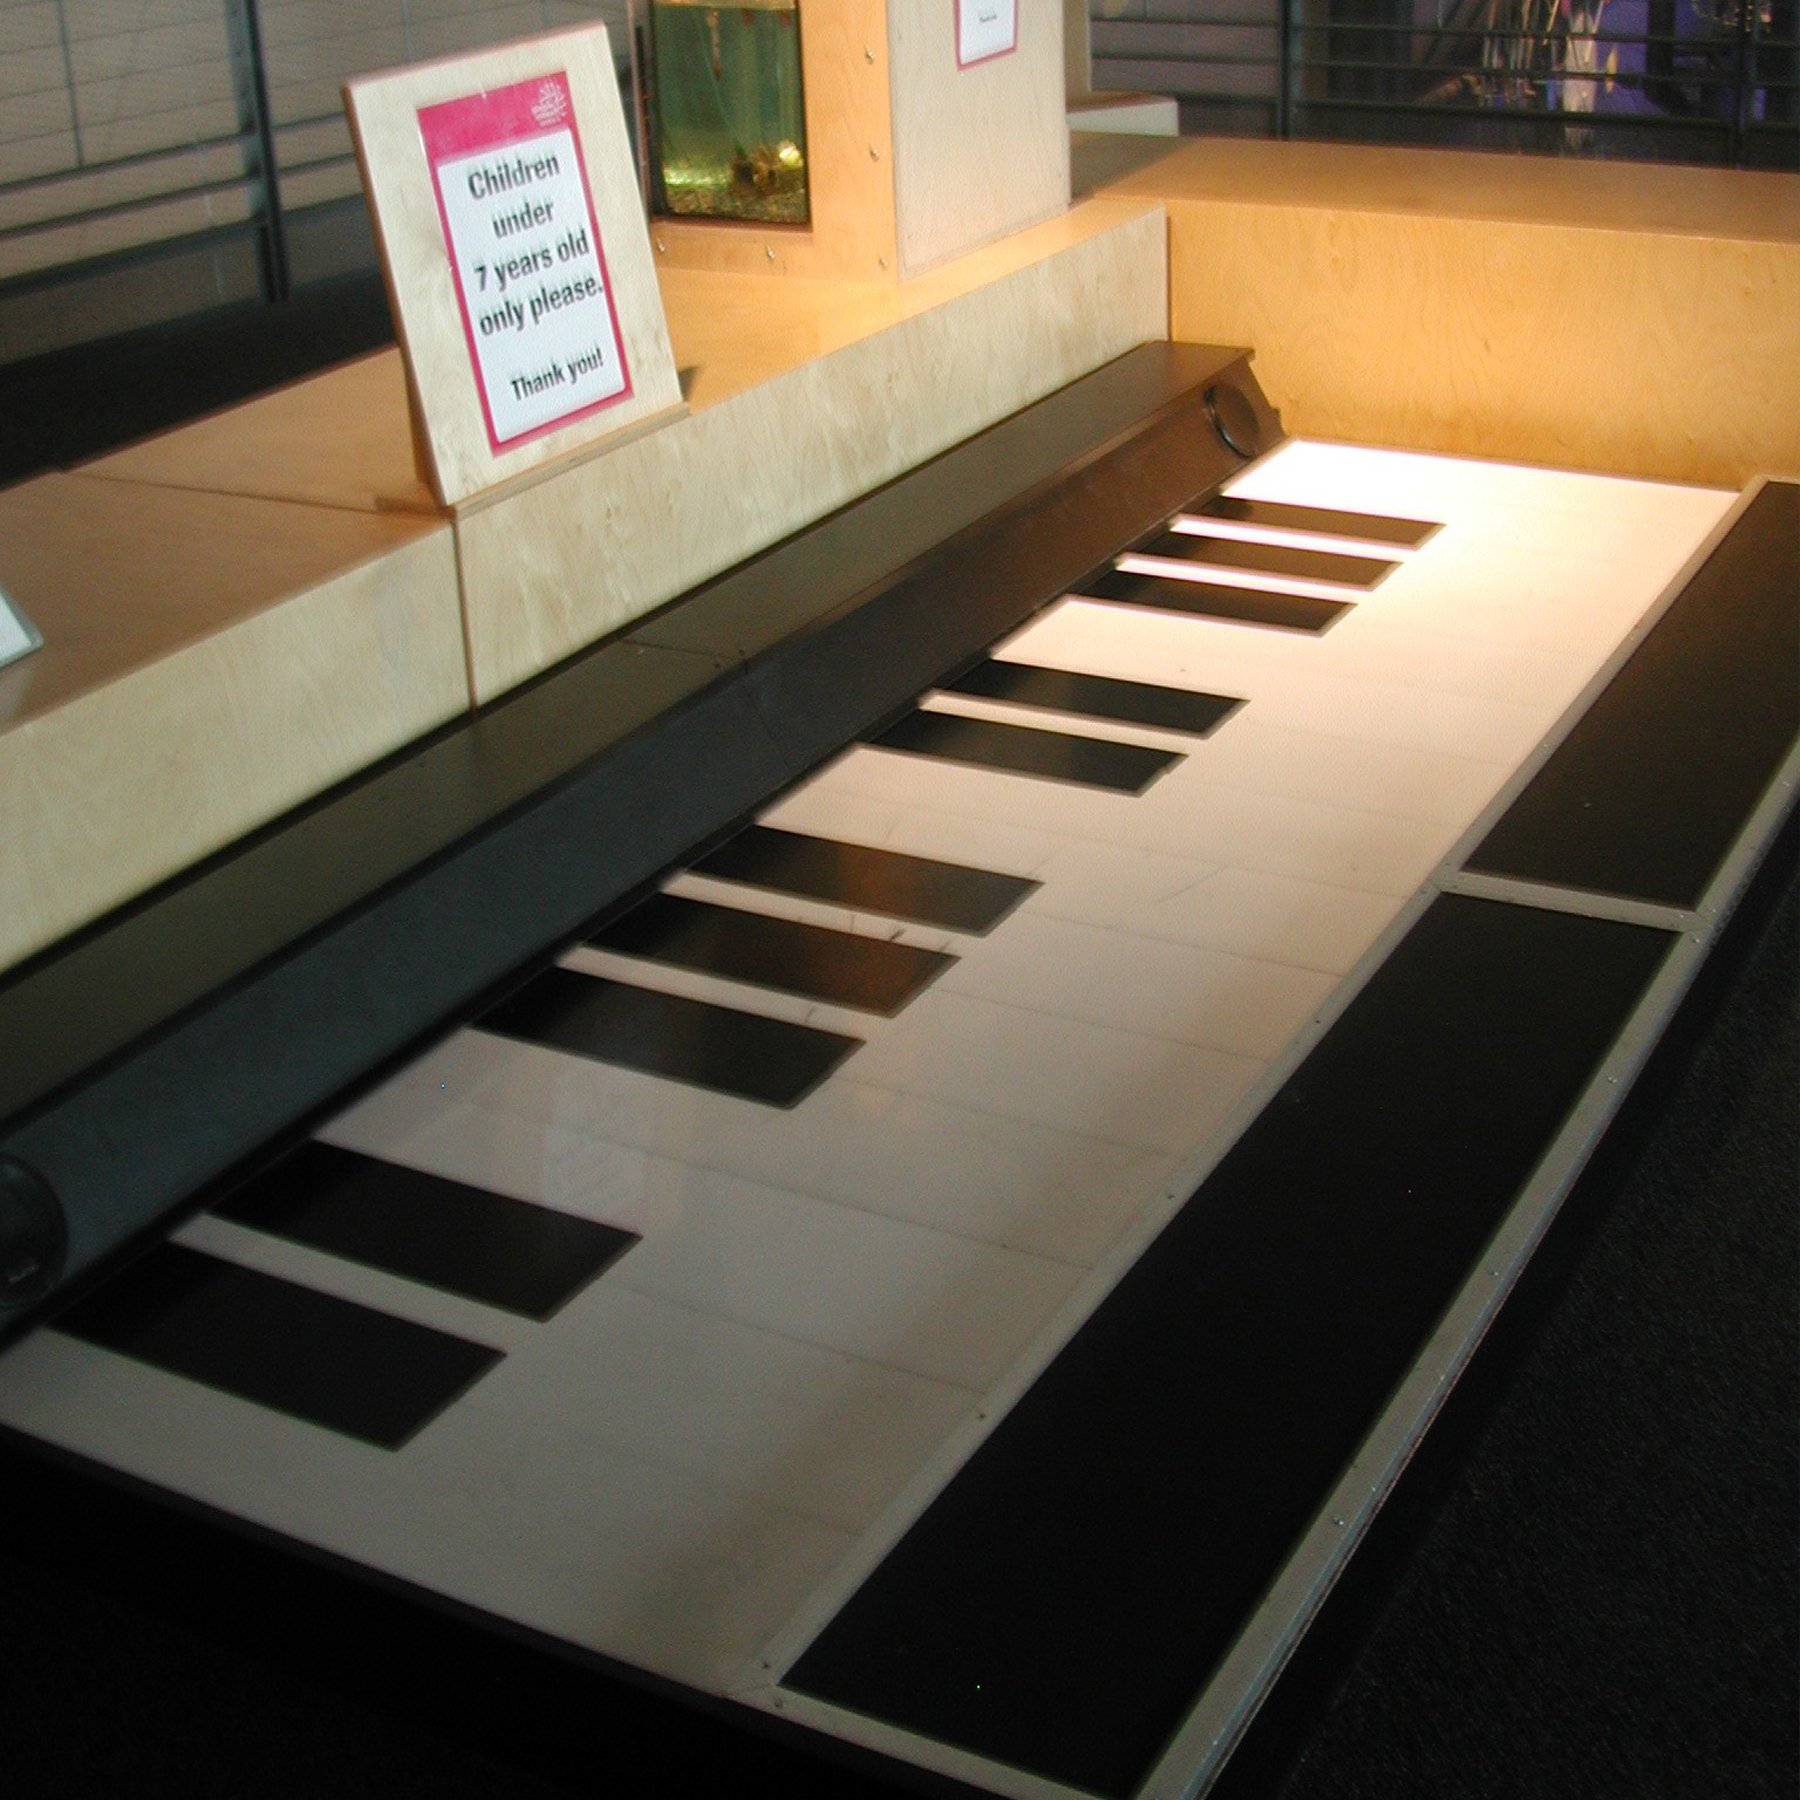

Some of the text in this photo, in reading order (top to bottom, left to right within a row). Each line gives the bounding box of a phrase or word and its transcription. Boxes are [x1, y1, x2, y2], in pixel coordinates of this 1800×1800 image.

[469, 154, 560, 200] Children
[493, 200, 554, 239] under
[474, 230, 590, 292] 7 years old
[480, 275, 604, 337] only please.
[511, 348, 604, 401] Thank you!
